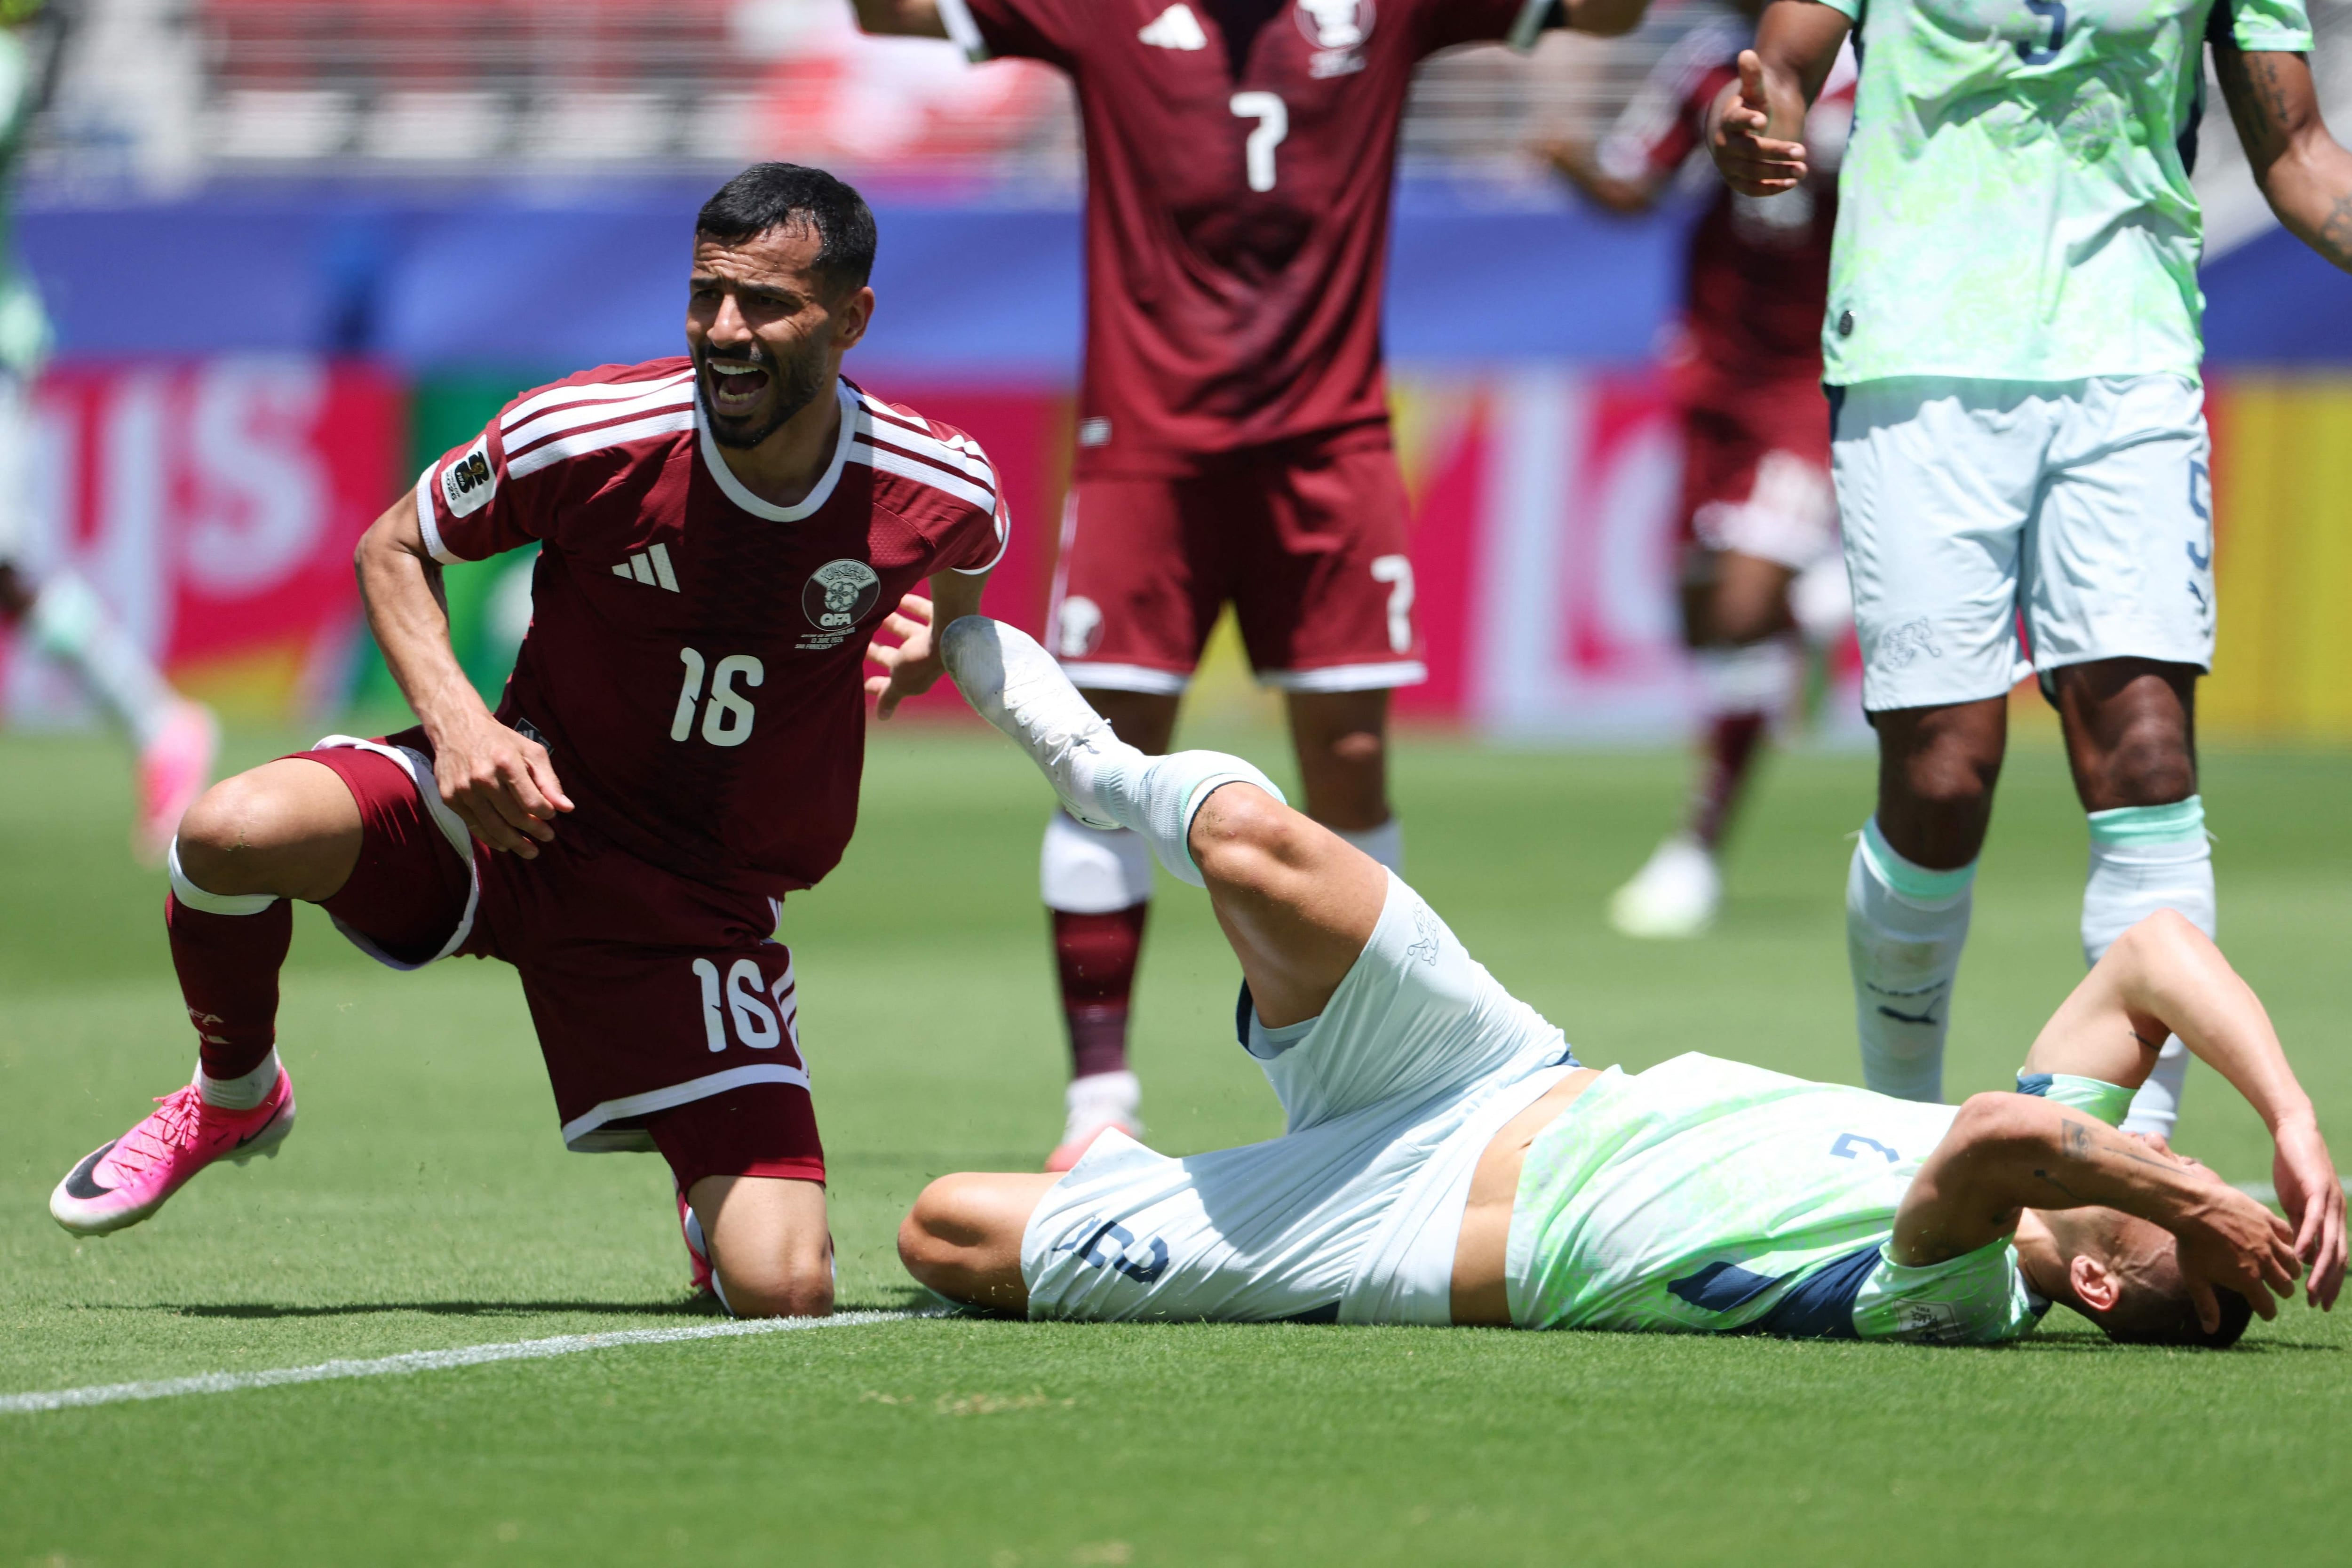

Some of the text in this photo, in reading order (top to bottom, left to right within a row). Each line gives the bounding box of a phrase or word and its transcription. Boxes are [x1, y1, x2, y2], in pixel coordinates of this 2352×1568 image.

[1230, 91, 1288, 192] 7
[820, 613, 851, 626] QFA
[1370, 554, 1415, 654] 7
[670, 647, 764, 747] 16
[692, 958, 781, 1052] 16
